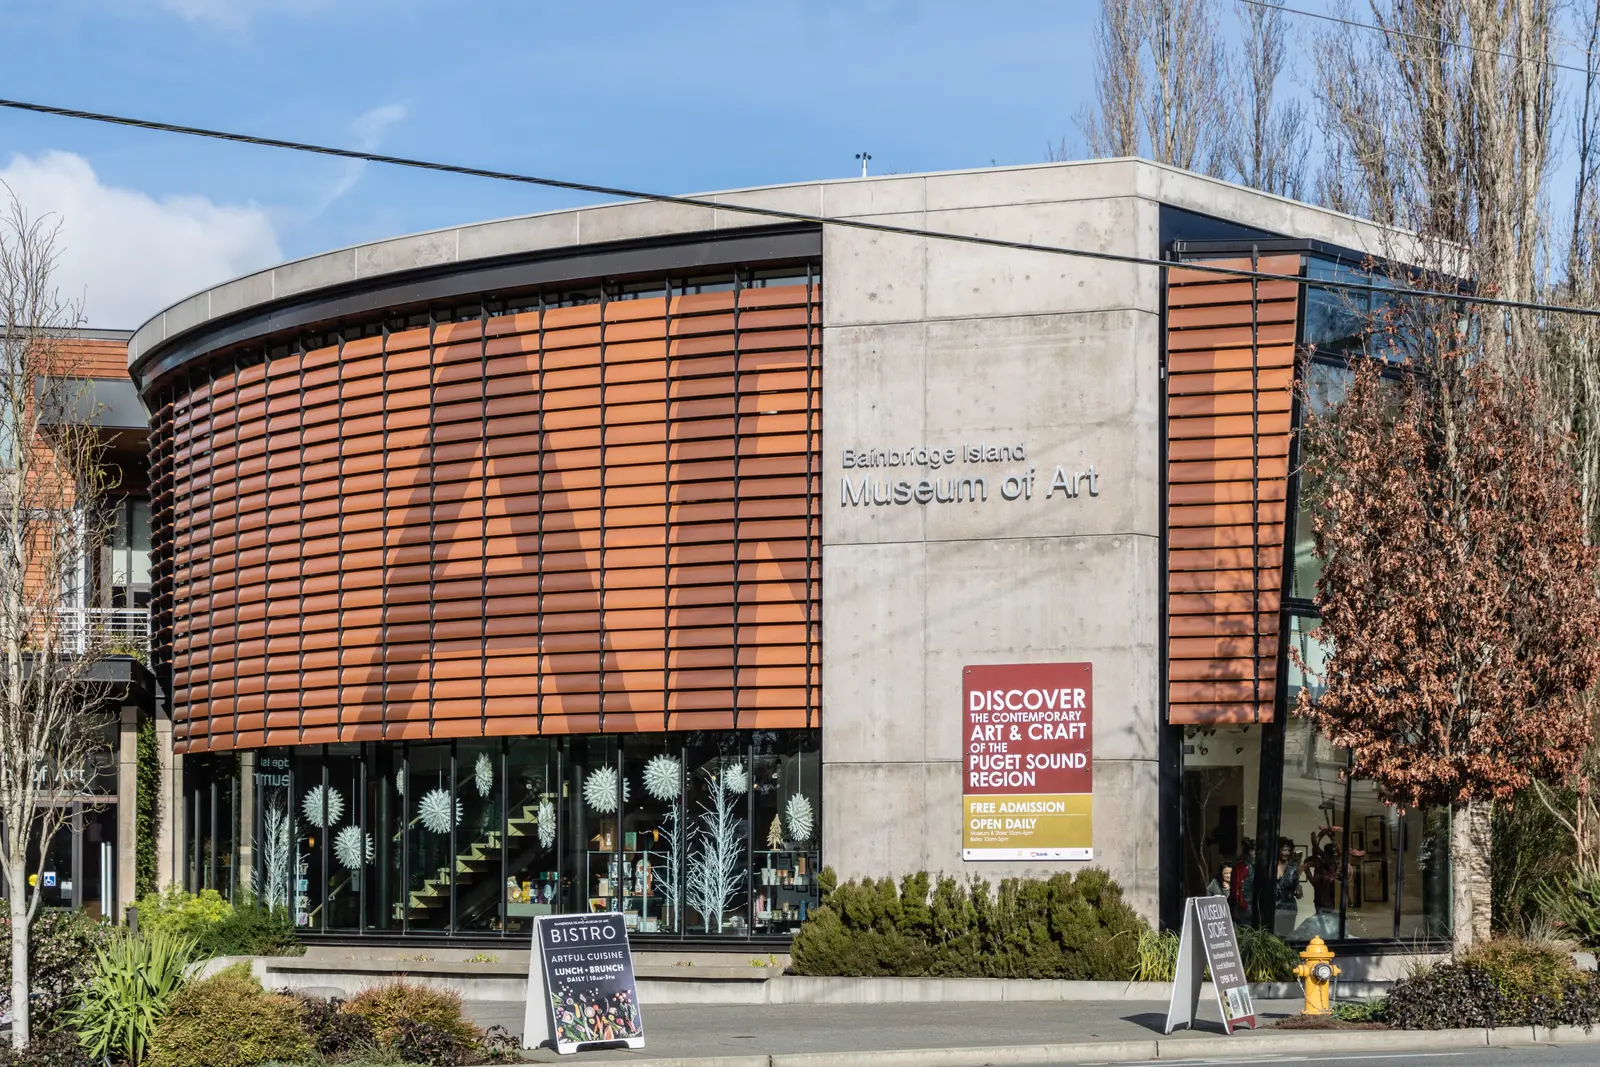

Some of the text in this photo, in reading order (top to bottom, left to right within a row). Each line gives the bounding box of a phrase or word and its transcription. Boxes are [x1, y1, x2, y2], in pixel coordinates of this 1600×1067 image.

[842, 442, 1025, 469] Bainbridge Island
[840, 464, 1099, 507] Museum of Art
[970, 688, 1086, 710] DISCOVER
[970, 711, 1082, 723] THE CONTEMPORARY
[970, 722, 1086, 741] ART & CRAFT
[970, 743, 1008, 753] OF THE
[970, 753, 1086, 770] PUGET SOUND
[970, 771, 1036, 787] REGION
[970, 802, 1064, 813] FREE ADMISSION
[970, 818, 1036, 830] OPEN DAILY
[1200, 904, 1228, 921] MUSEUM
[551, 926, 616, 943] BISTRO
[1208, 921, 1228, 938] STORE
[551, 951, 623, 963] ARTFUL CUISINE
[555, 964, 624, 975] LUNCH BRUNCH
